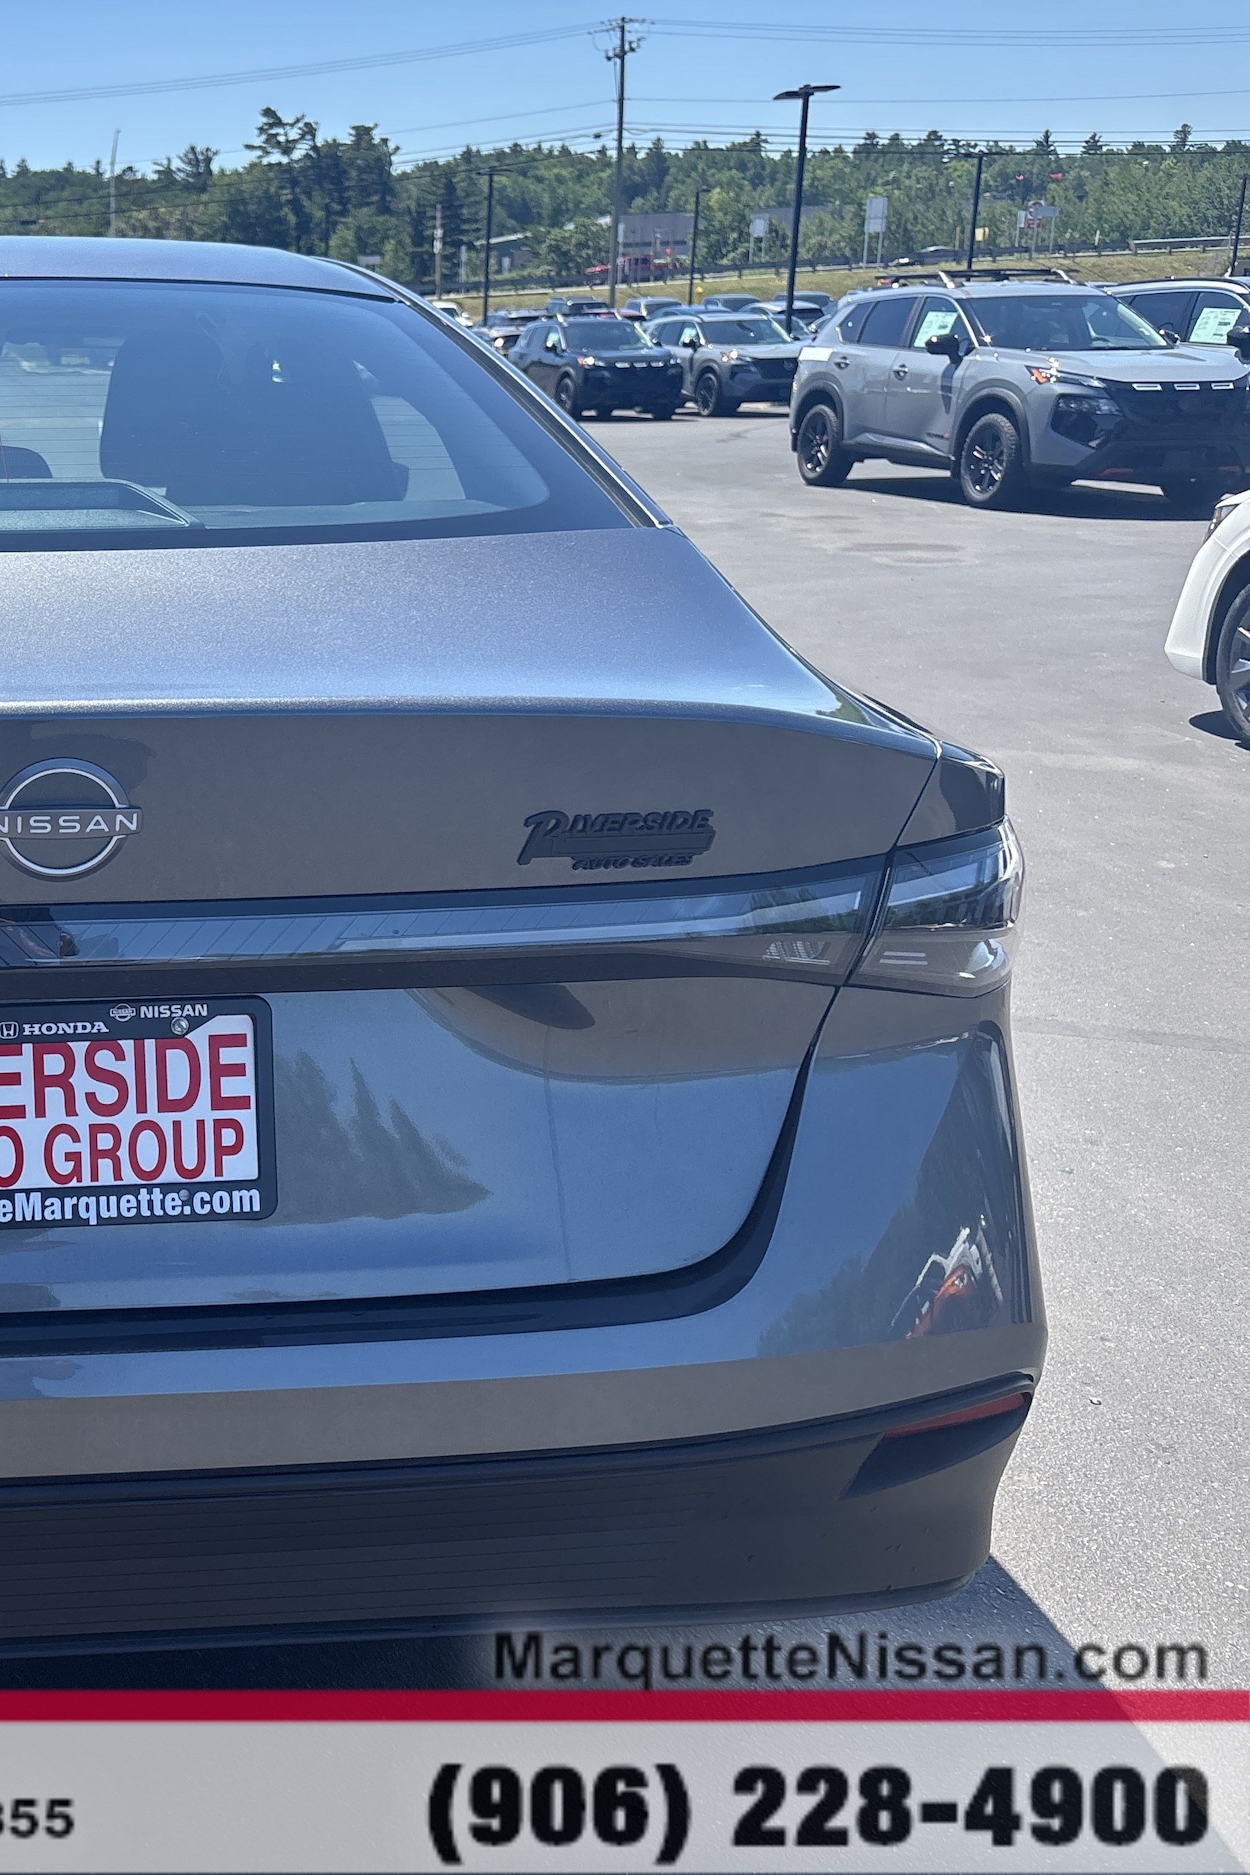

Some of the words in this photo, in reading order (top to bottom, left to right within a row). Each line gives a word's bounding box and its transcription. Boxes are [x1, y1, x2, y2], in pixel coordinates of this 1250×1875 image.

[517, 809, 714, 865] RIVERSIDE
[22, 1021, 110, 1036] HONDA
[139, 1003, 209, 1019] NISSAN
[43, 1118, 245, 1185] GROUP
